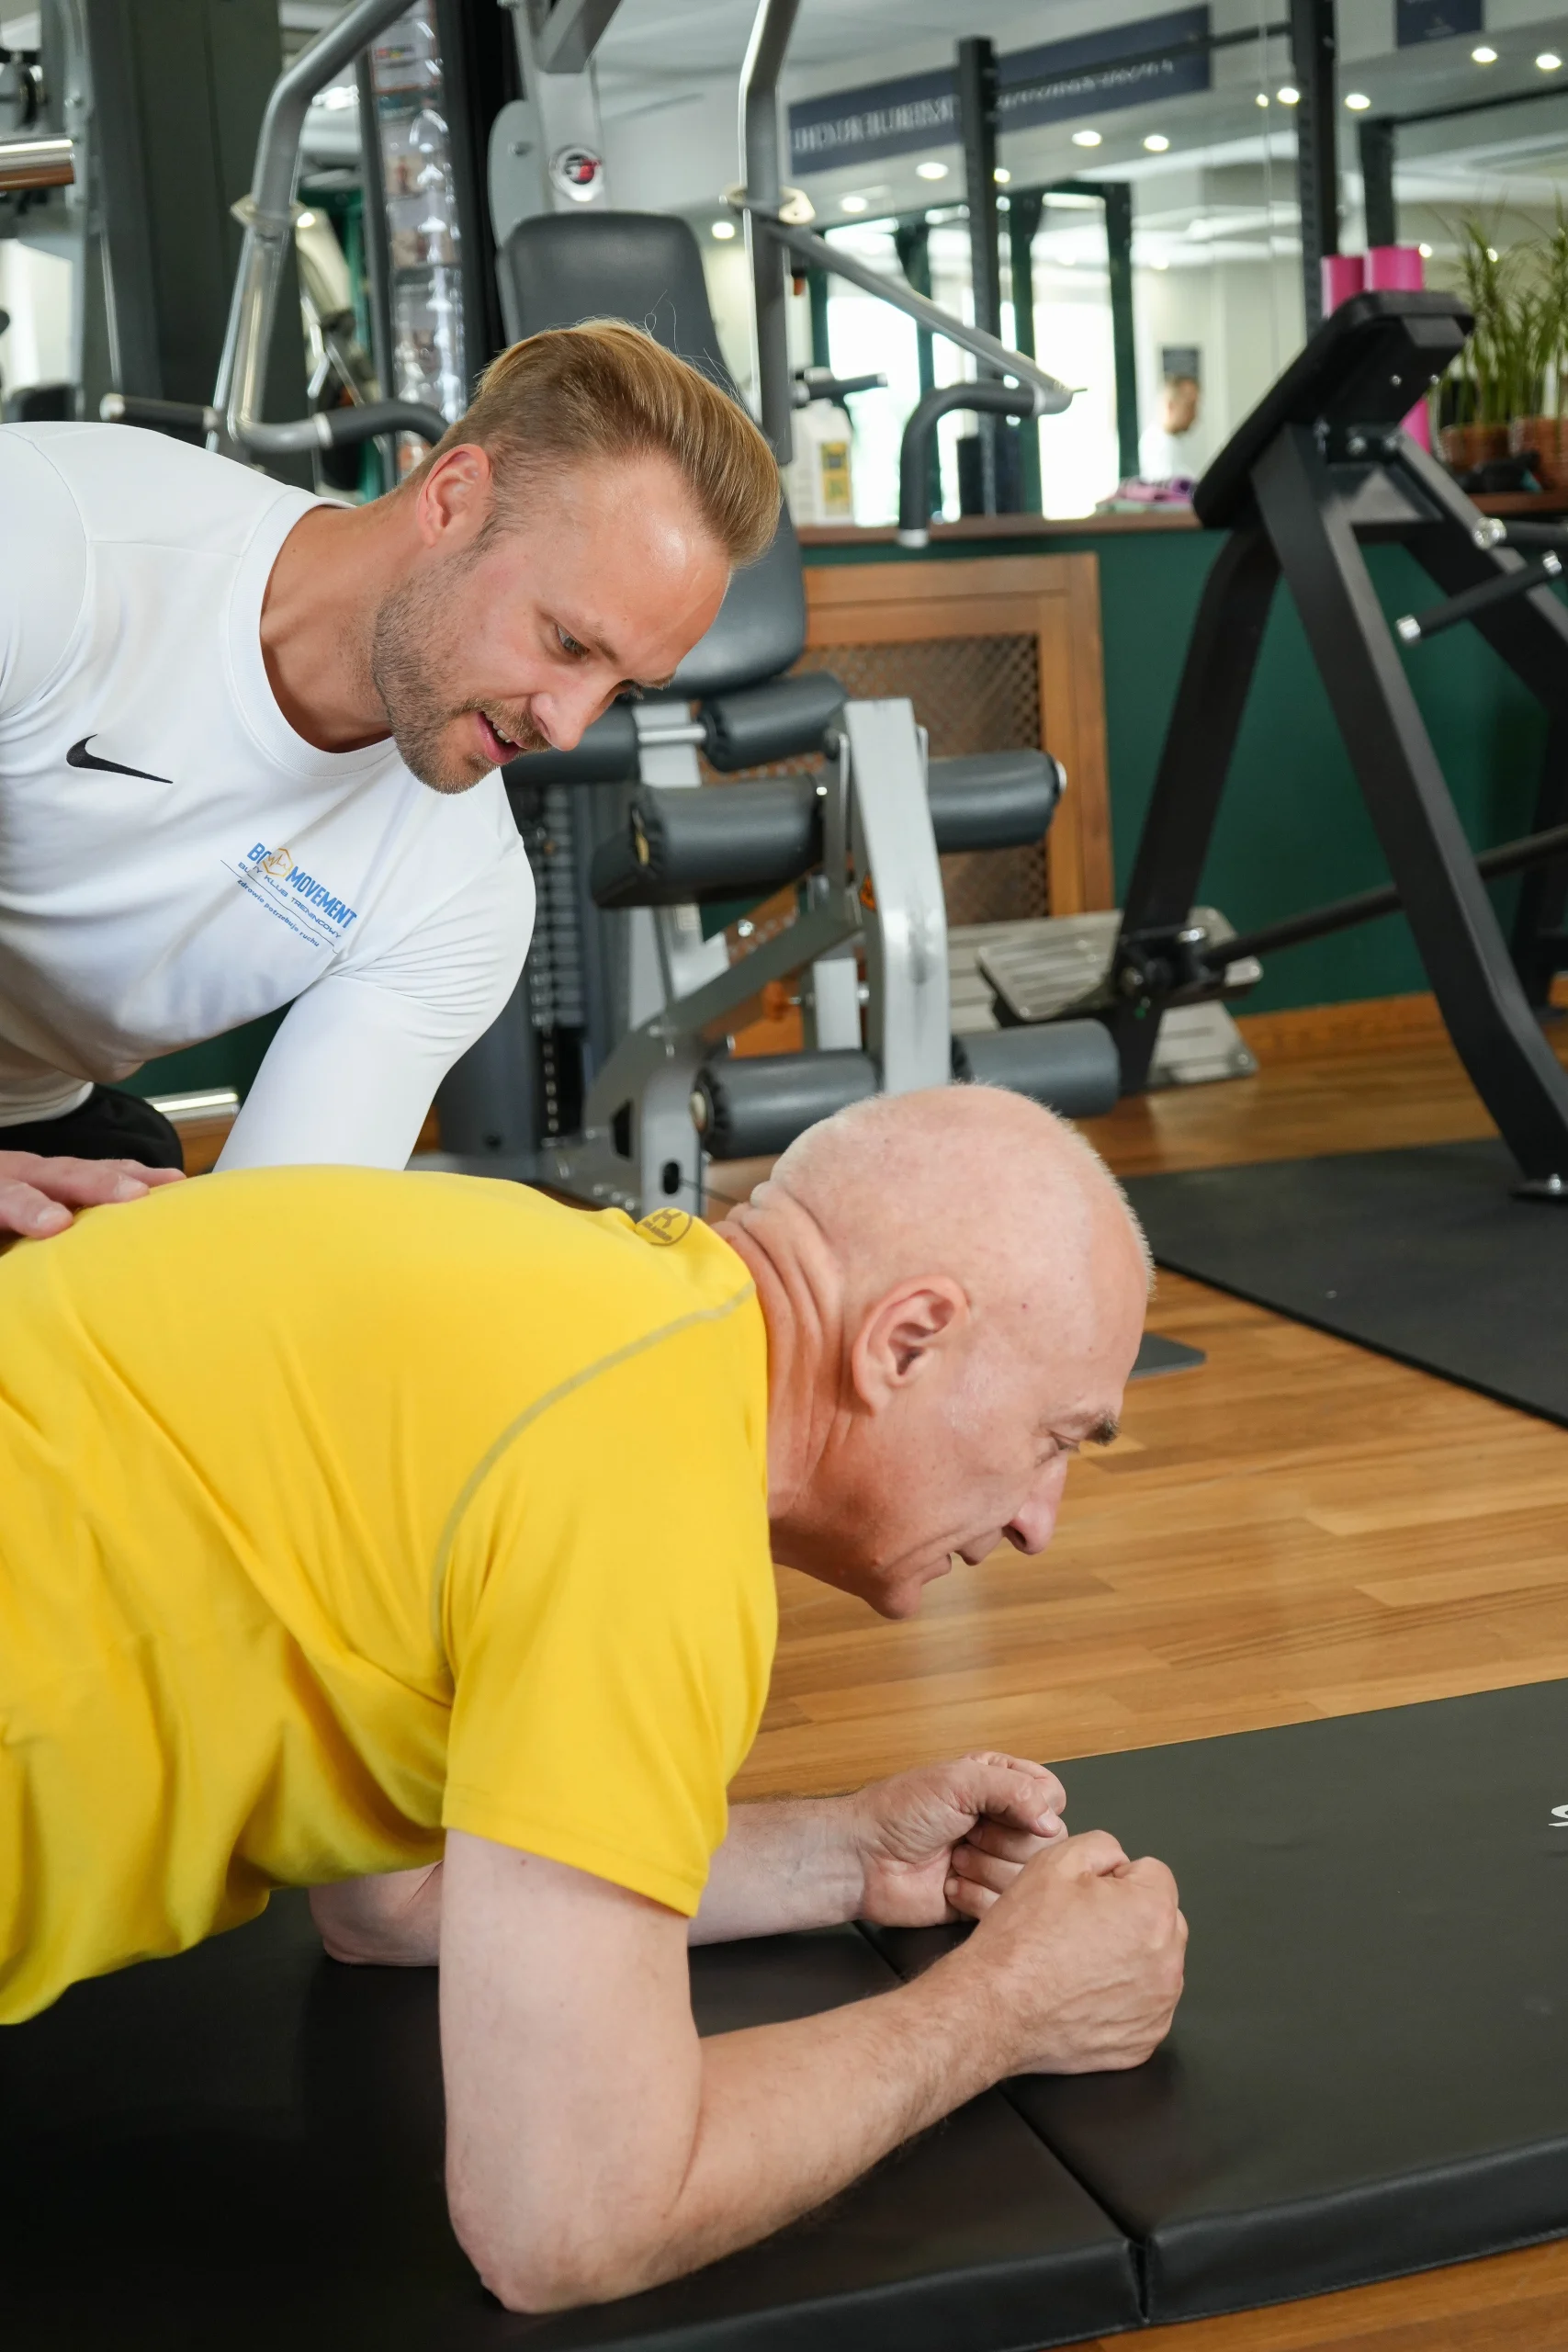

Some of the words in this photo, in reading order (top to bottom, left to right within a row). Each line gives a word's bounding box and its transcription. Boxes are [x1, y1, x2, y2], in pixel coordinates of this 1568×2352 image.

[237, 879, 265, 903] zdrowie
[264, 902, 299, 933] potrzebuje
[299, 931, 321, 947] ruchu
[265, 875, 288, 898] KLUB
[285, 866, 357, 929] MOVEMENT
